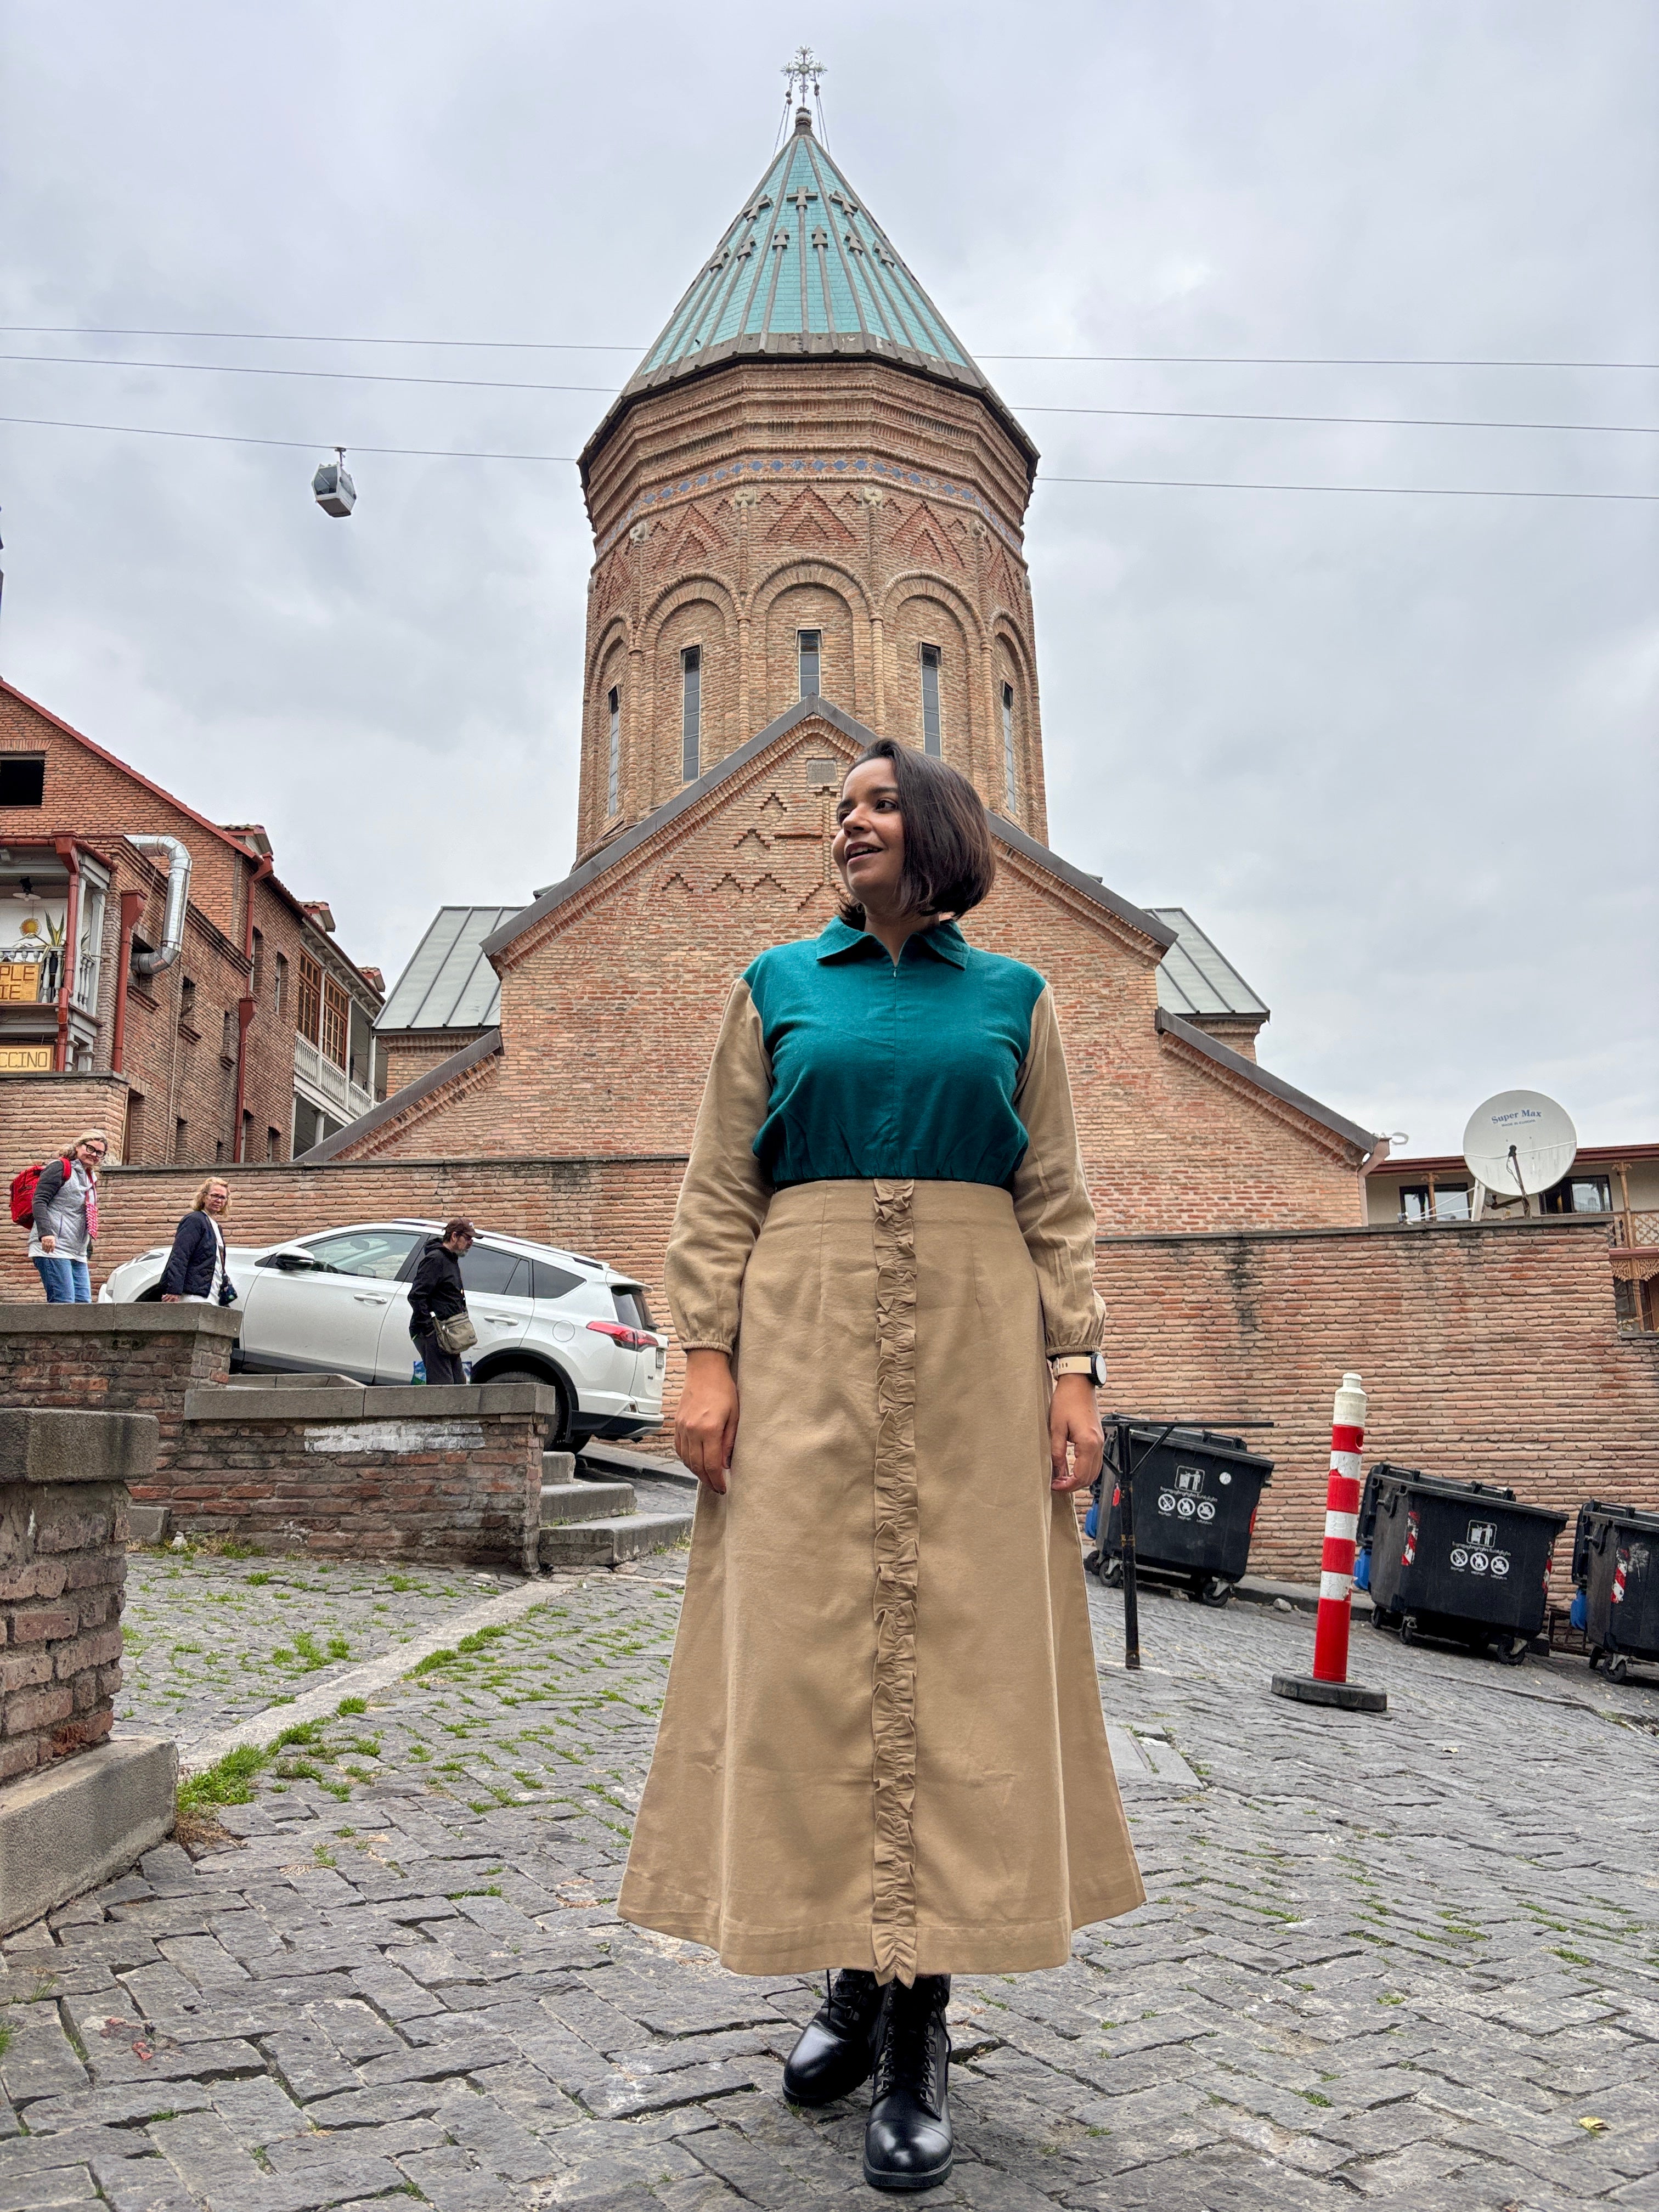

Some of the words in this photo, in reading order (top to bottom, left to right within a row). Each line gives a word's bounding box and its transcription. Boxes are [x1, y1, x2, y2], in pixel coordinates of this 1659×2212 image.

[0, 966, 35, 981] PLE
[1491, 1113, 1519, 1124] Super
[1521, 1109, 1542, 1118] Max
